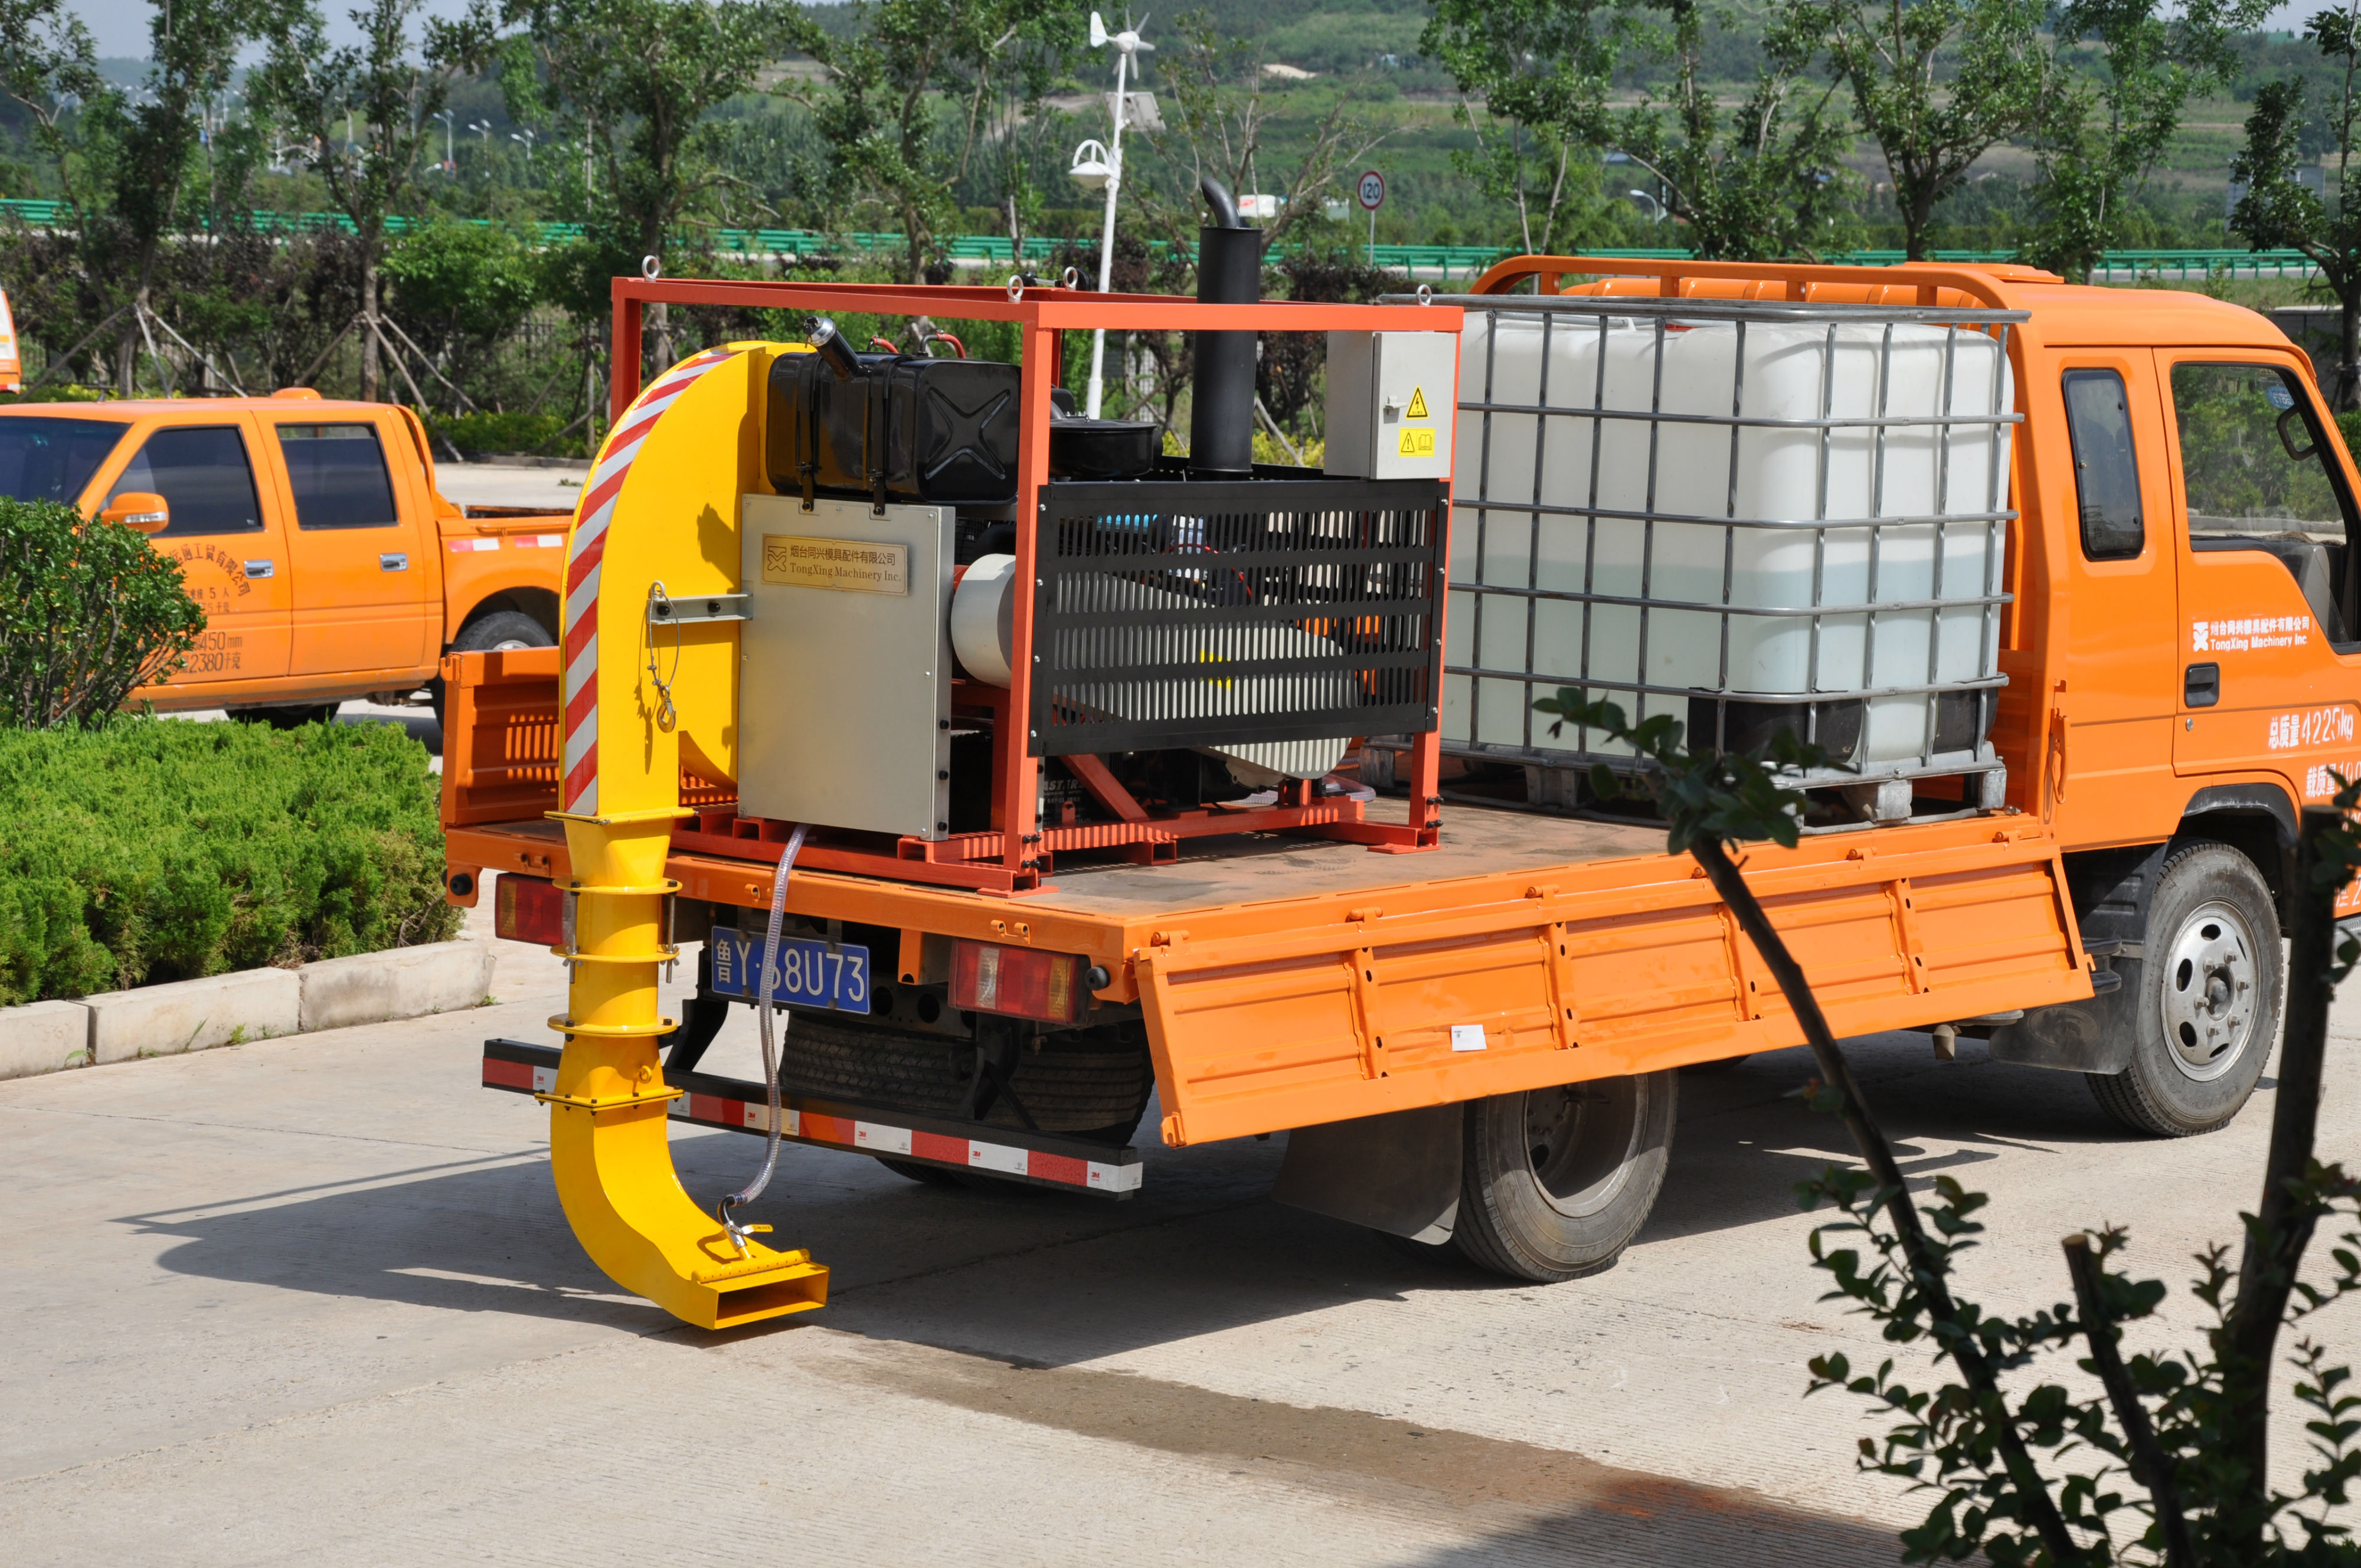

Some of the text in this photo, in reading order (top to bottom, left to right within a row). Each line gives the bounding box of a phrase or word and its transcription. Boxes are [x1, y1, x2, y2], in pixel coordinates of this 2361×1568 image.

[1363, 183, 1380, 199] 120
[790, 544, 895, 565] 烟台同兴模具配件有限公司
[790, 562, 901, 582] TongXing Machinery Inc.
[2210, 616, 2310, 636] 烟台同兴模具配件有限公司
[2210, 637, 2248, 652] TongXing
[2251, 635, 2292, 649] Machinery
